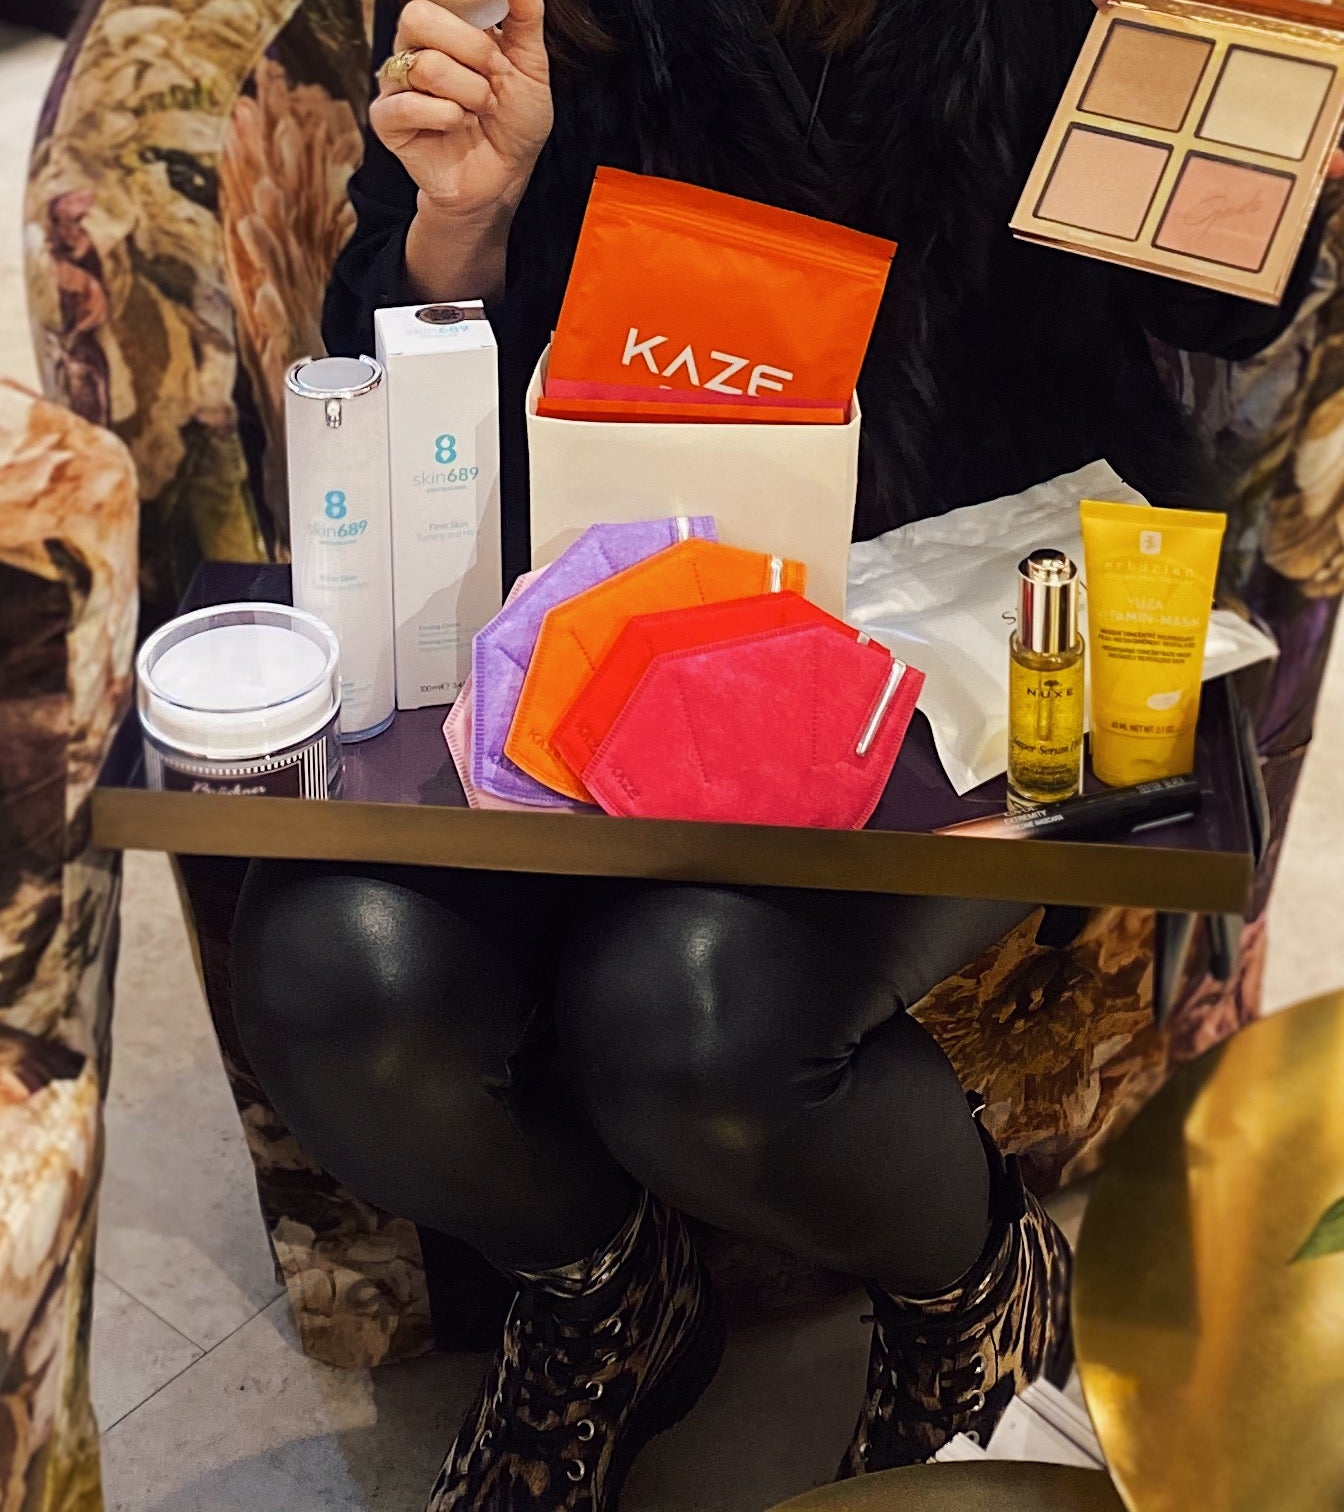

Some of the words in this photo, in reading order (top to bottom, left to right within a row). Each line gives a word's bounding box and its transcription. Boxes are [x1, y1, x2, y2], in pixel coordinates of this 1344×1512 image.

[435, 433, 457, 464] 8
[413, 466, 480, 487] skin689
[324, 489, 347, 519] 8
[306, 519, 369, 539] skin689
[1026, 687, 1074, 699] NUXE
